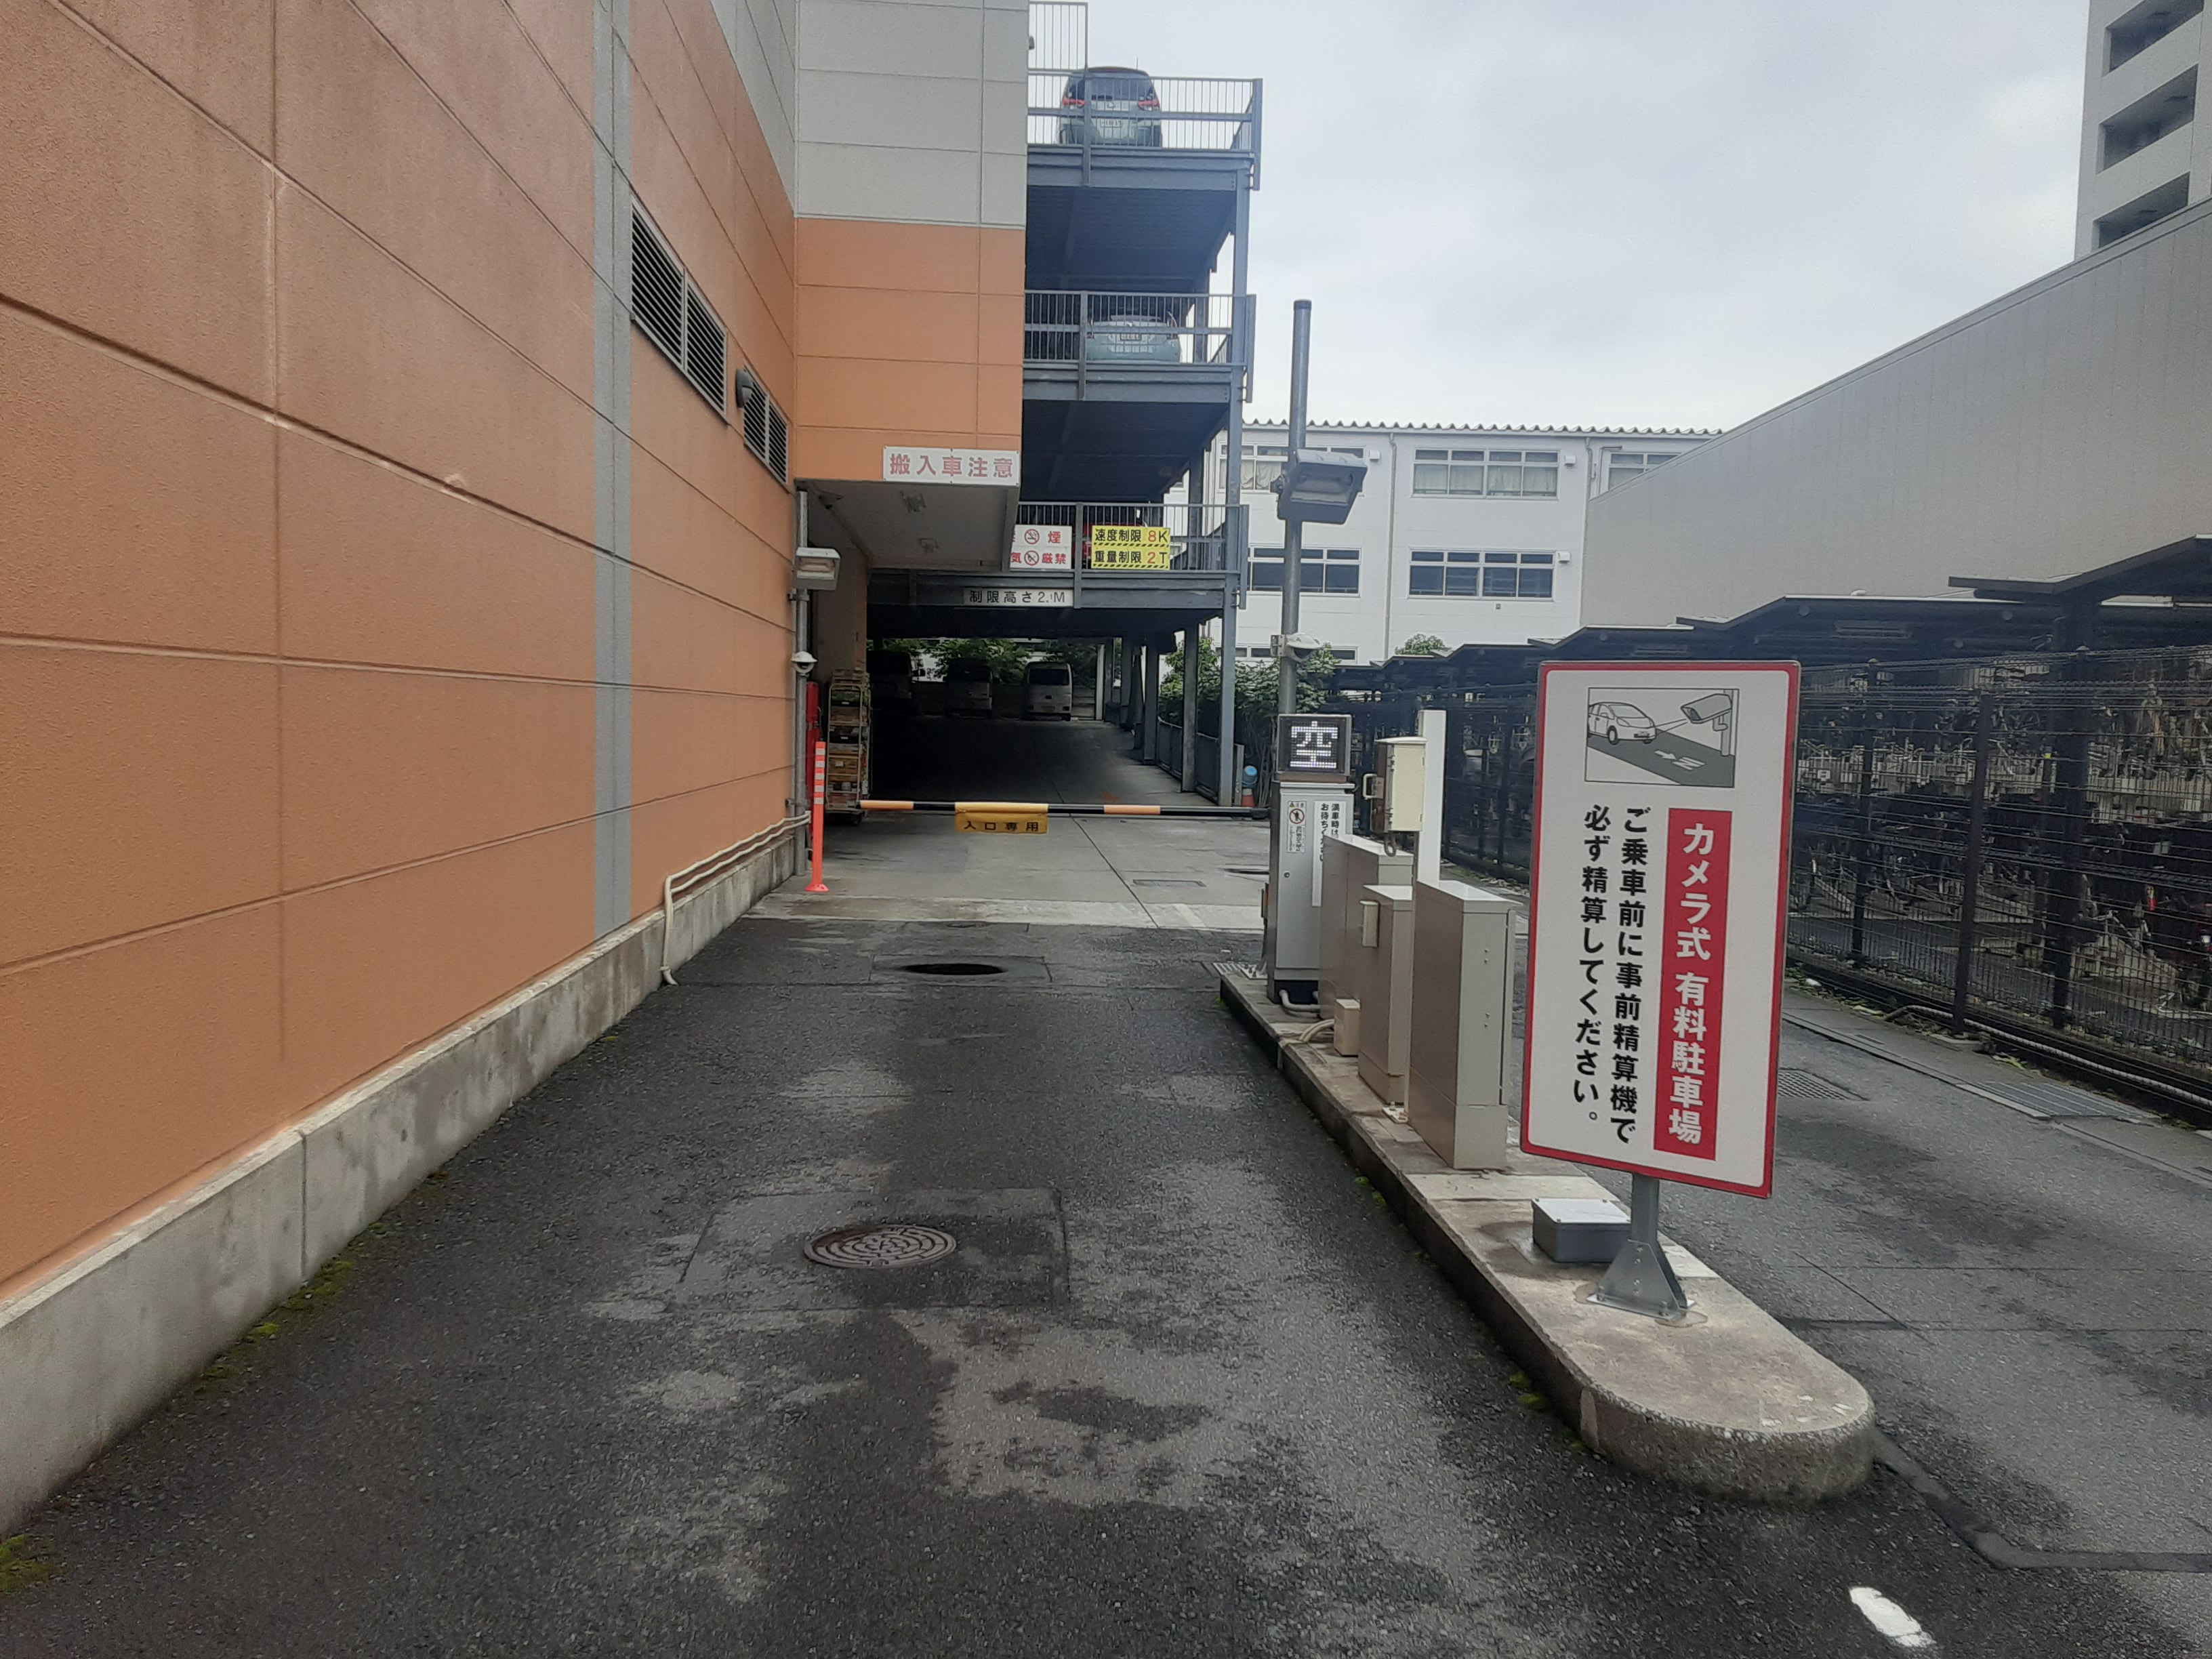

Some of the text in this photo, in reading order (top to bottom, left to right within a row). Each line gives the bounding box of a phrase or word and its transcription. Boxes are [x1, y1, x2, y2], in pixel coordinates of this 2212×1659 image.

[890, 453, 1013, 478] 搬入車注意
[1094, 528, 1141, 542] 速度制限
[1094, 550, 1142, 564] 重量制限
[1290, 720, 1338, 769] 空
[964, 821, 1039, 832] 入口専用
[1573, 804, 1612, 1123] 必ず精算してください。
[1610, 806, 1652, 1144] ご乗車前に事前精算機で
[1668, 823, 1715, 1145] カメラ式 有料駐車場
